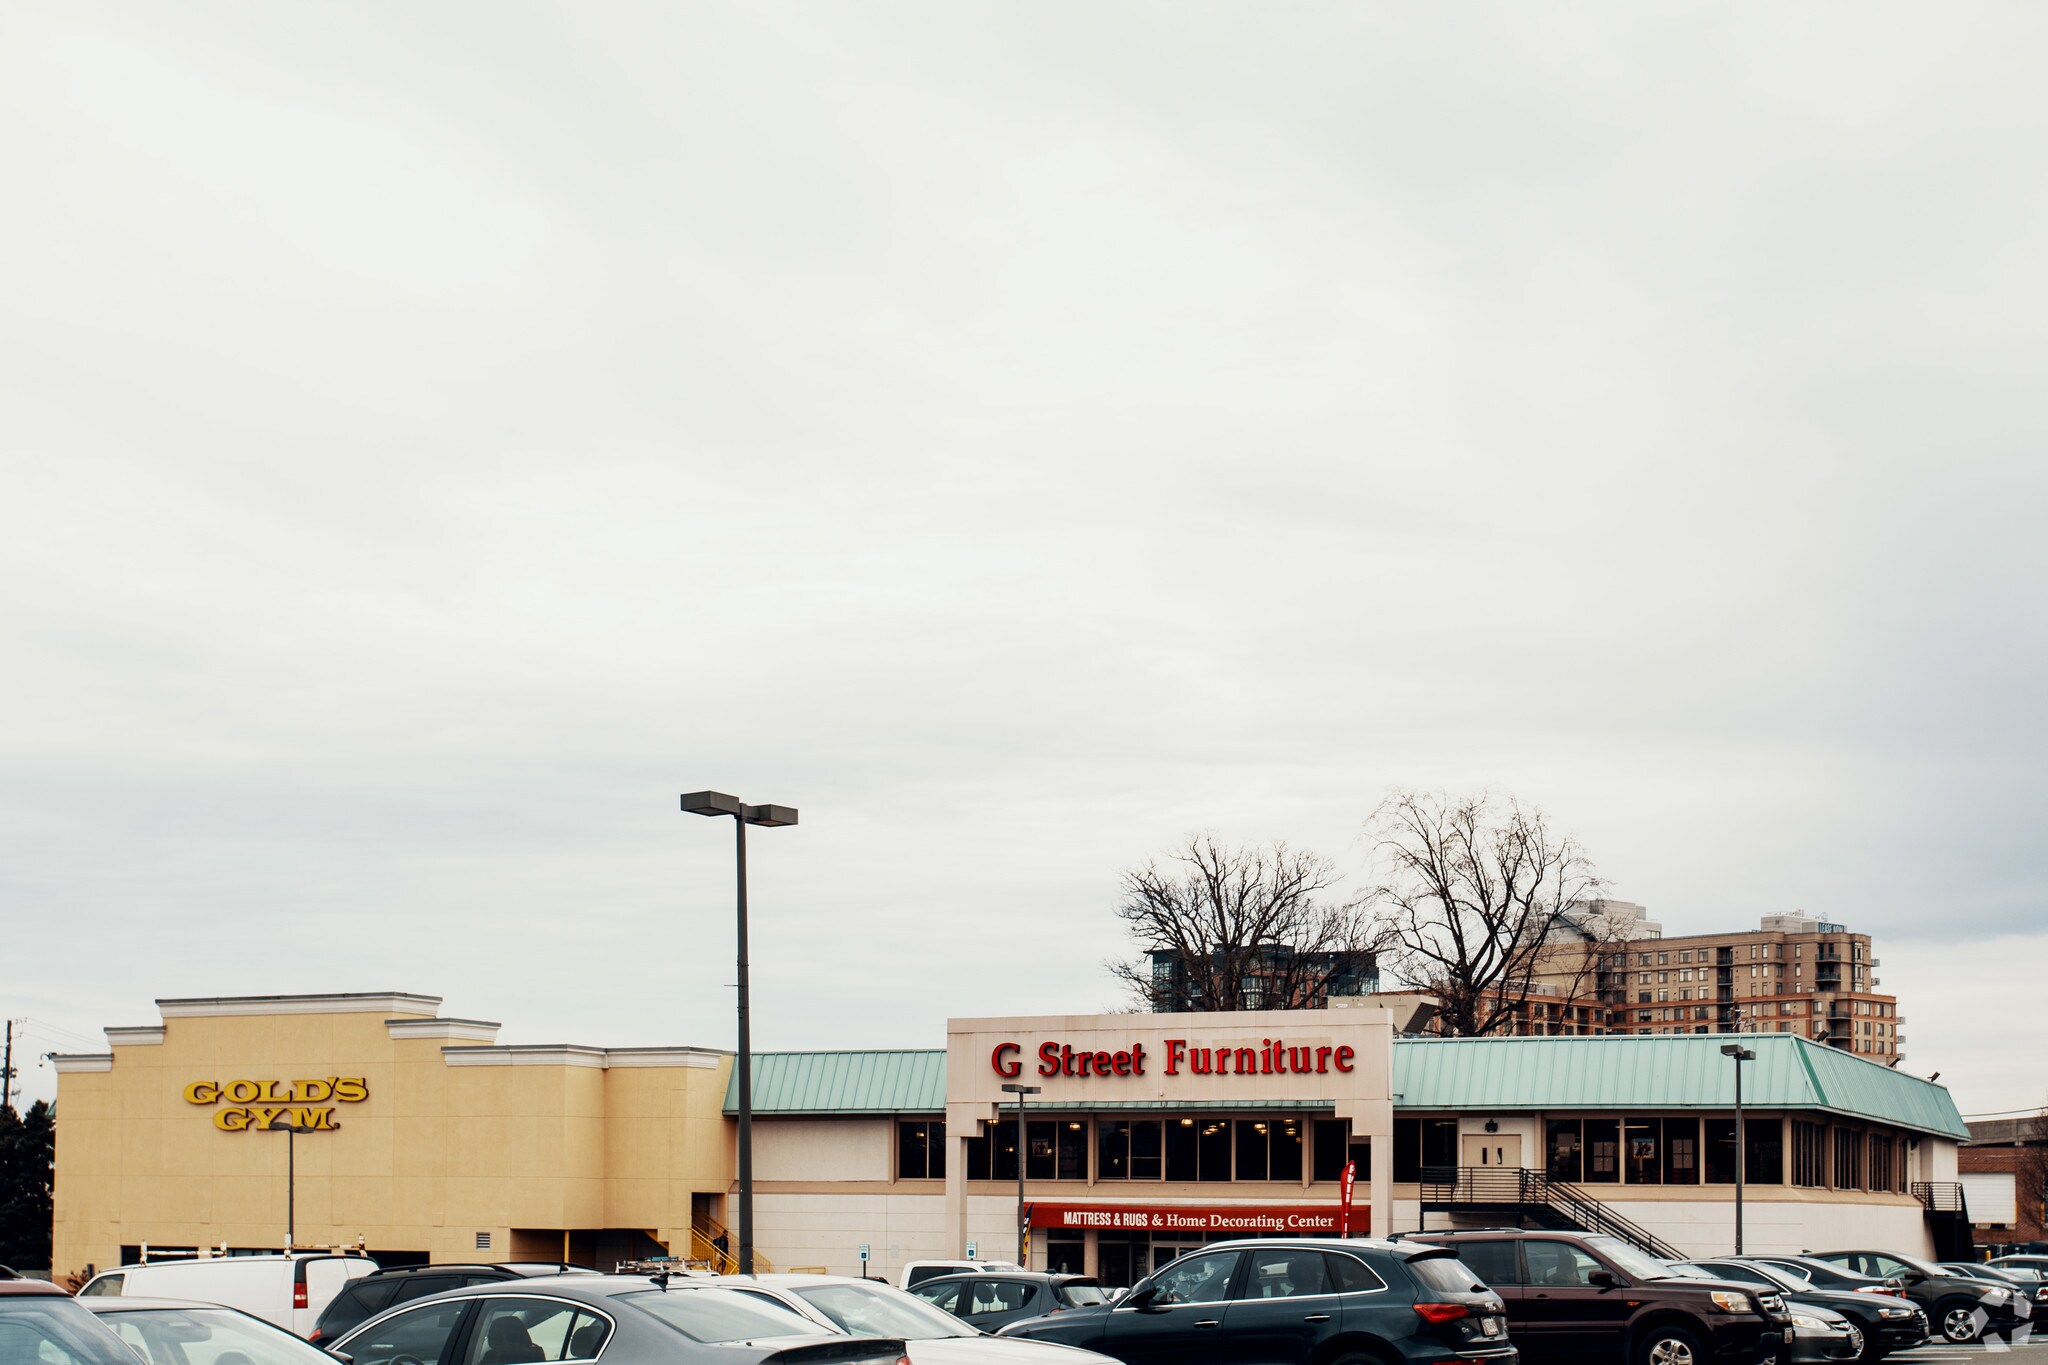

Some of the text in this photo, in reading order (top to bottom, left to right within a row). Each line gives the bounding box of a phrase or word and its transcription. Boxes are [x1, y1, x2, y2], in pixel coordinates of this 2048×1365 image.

[991, 1038, 1354, 1077] G Street Furniture
[183, 1077, 369, 1105] GOLD'S
[1064, 1211, 1334, 1231] MATTRESS & RUGS & Home Decorating Center
